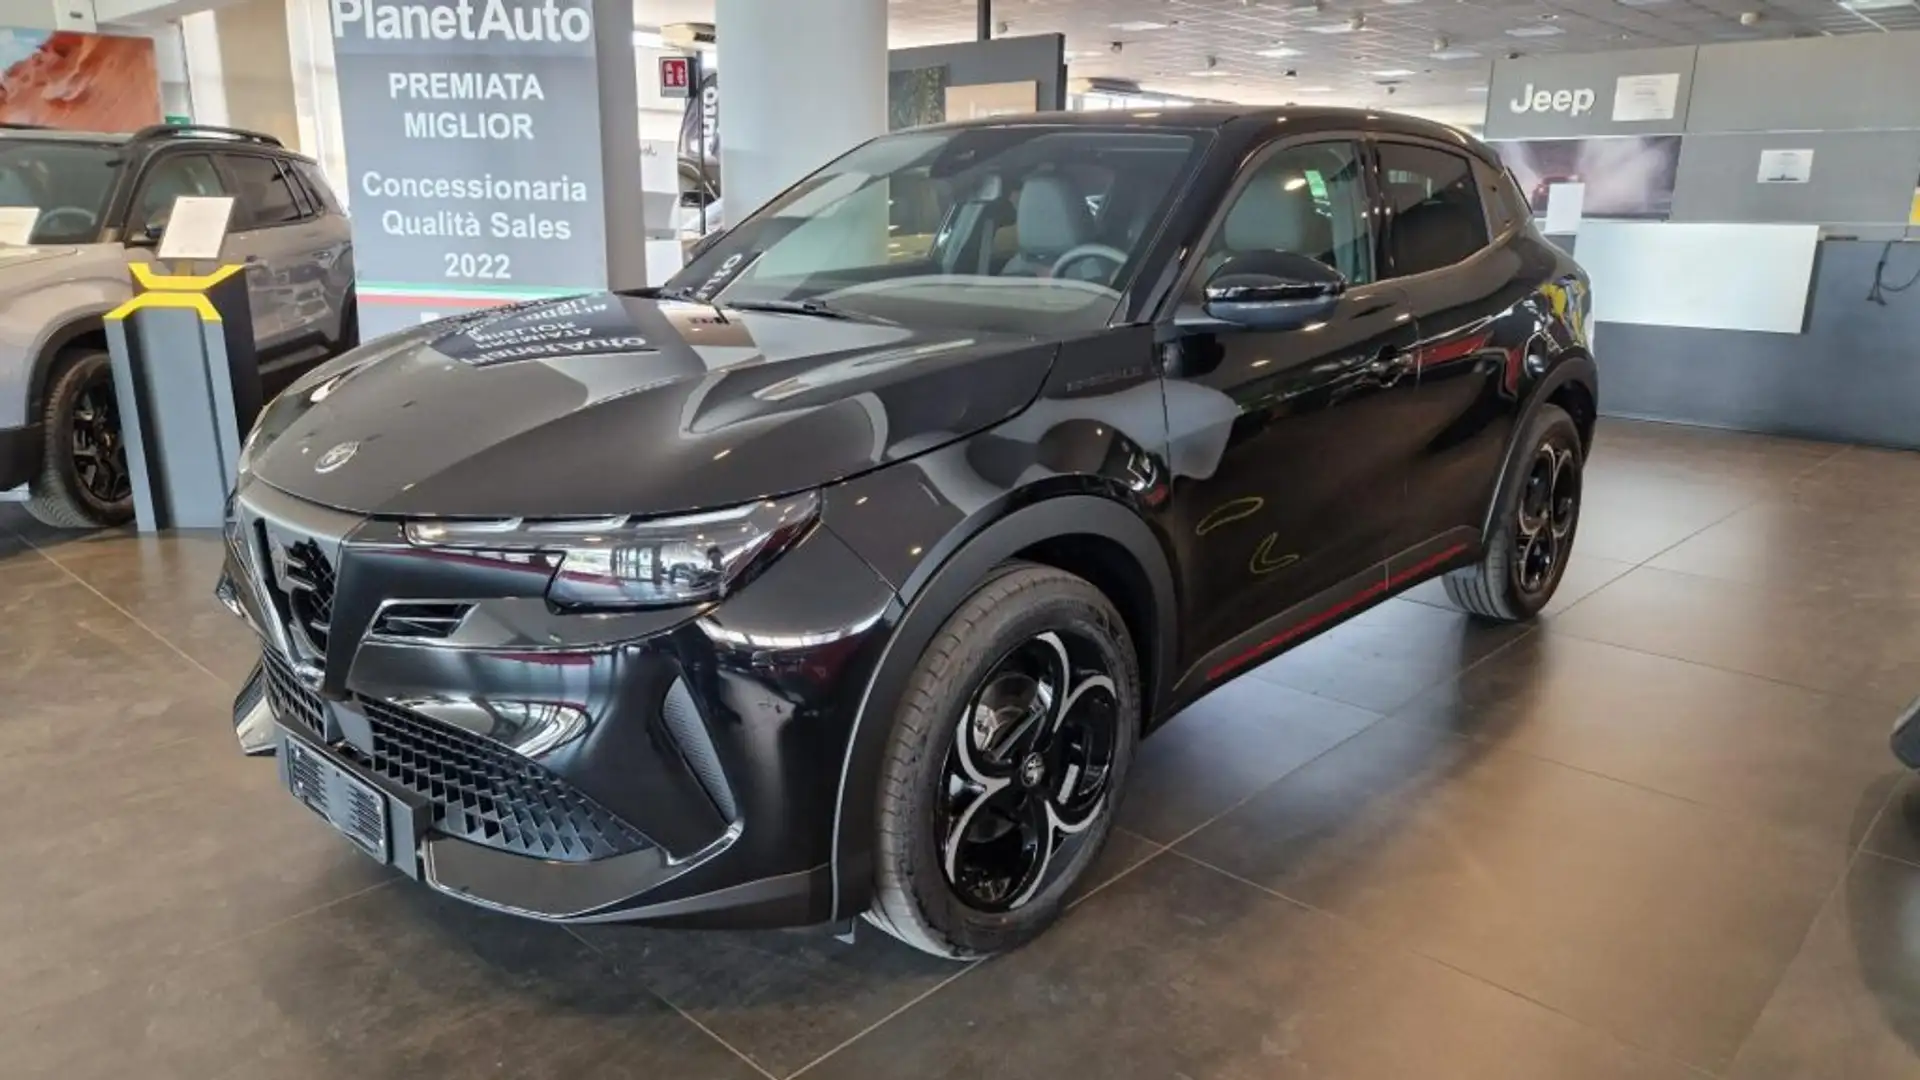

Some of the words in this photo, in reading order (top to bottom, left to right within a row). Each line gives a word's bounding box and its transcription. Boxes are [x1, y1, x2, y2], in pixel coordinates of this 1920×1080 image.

[332, 0, 592, 43] PlanetAuto
[388, 72, 545, 100] PREMIATA
[1509, 83, 1596, 117] Jeep
[404, 112, 534, 140] MIGLIOR
[361, 170, 588, 202] Concessionaria
[381, 209, 481, 237] Qualità
[490, 212, 572, 241] Sales
[444, 252, 512, 280] 2022
